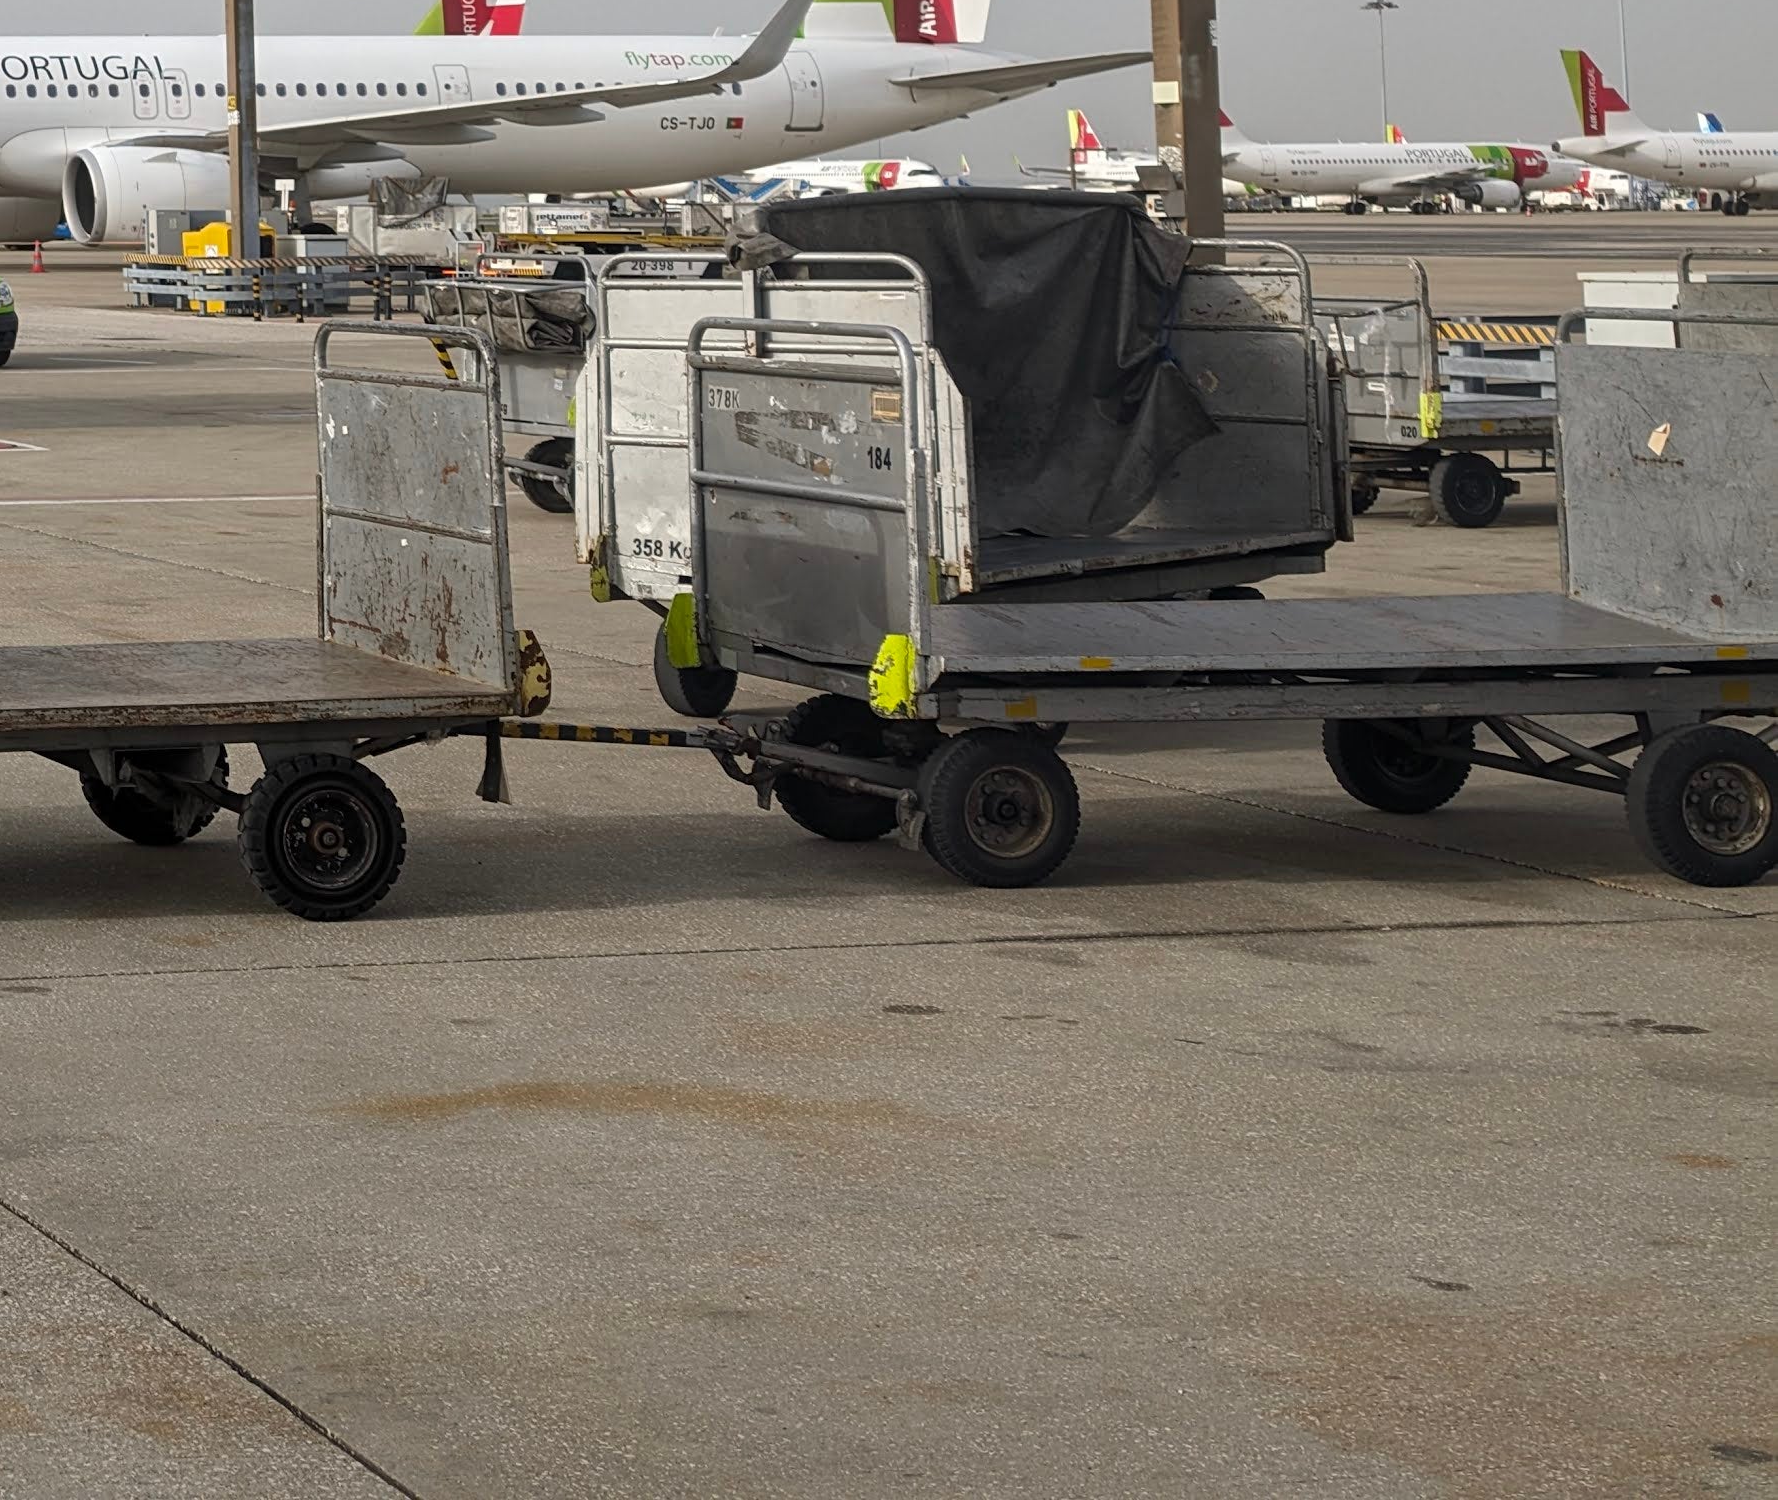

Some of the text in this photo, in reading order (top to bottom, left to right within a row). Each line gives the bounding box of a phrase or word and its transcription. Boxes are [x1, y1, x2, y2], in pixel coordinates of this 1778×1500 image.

[625, 51, 735, 70] flytap.com
[1405, 149, 1468, 159] PORTUGAL
[632, 260, 673, 270] 20-398
[709, 388, 740, 408] 378K
[1401, 426, 1417, 438] 020
[868, 446, 891, 470] 184
[633, 539, 663, 557] 358
